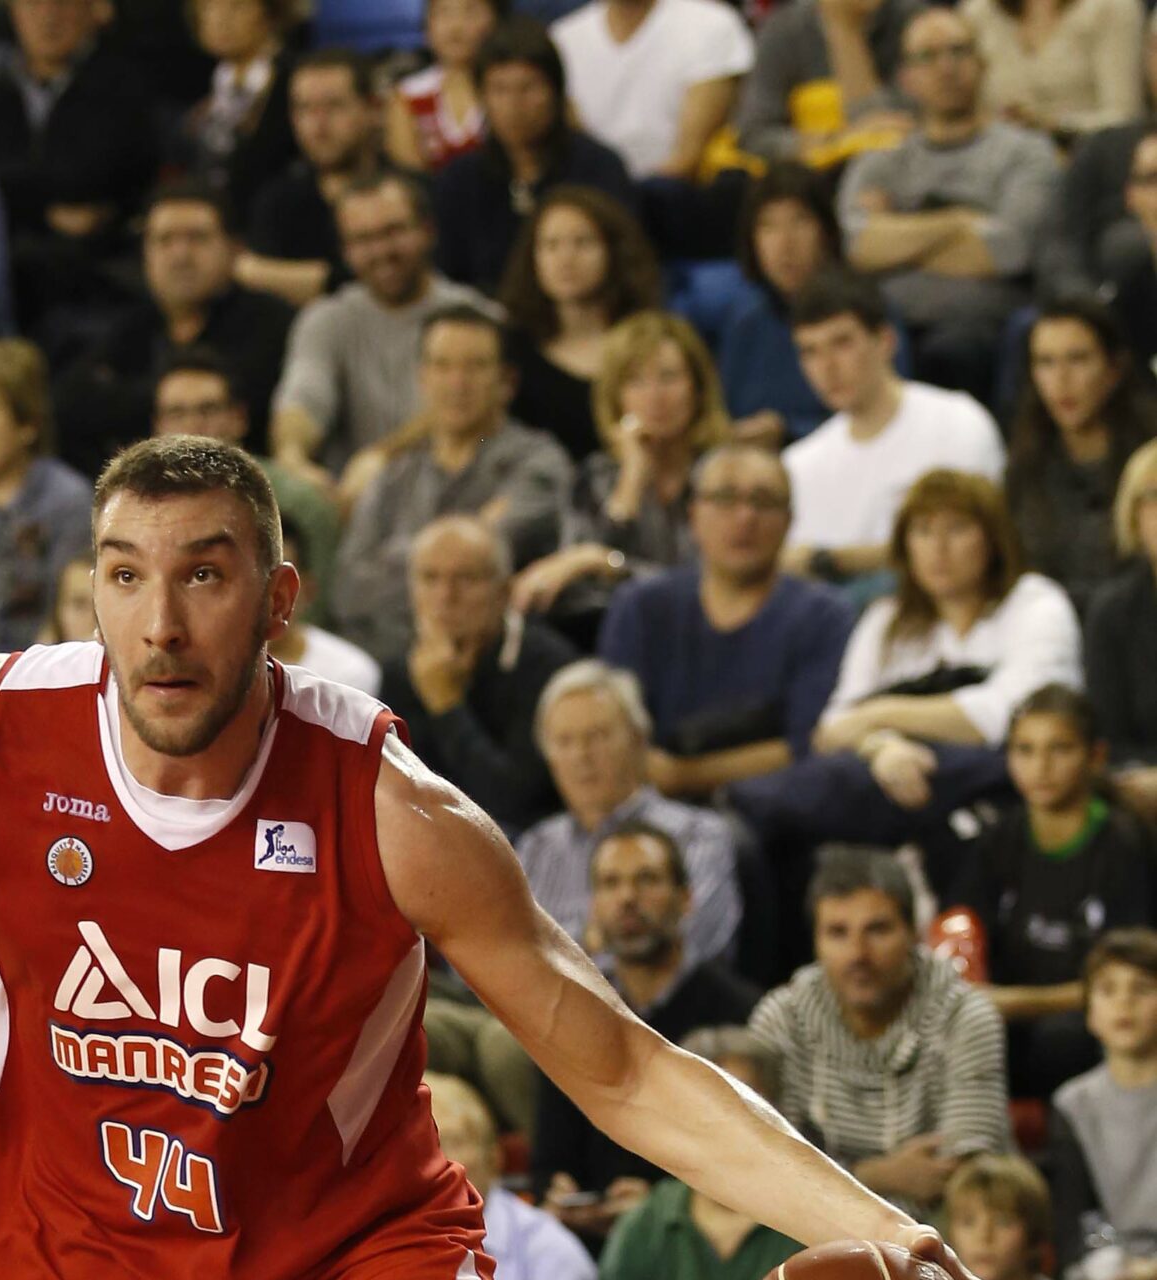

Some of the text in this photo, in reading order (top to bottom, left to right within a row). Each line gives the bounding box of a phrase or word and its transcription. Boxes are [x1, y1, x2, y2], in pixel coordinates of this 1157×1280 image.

[275, 855, 314, 866] endesa
[158, 947, 277, 1052] ICL
[101, 1121, 223, 1233] 44
